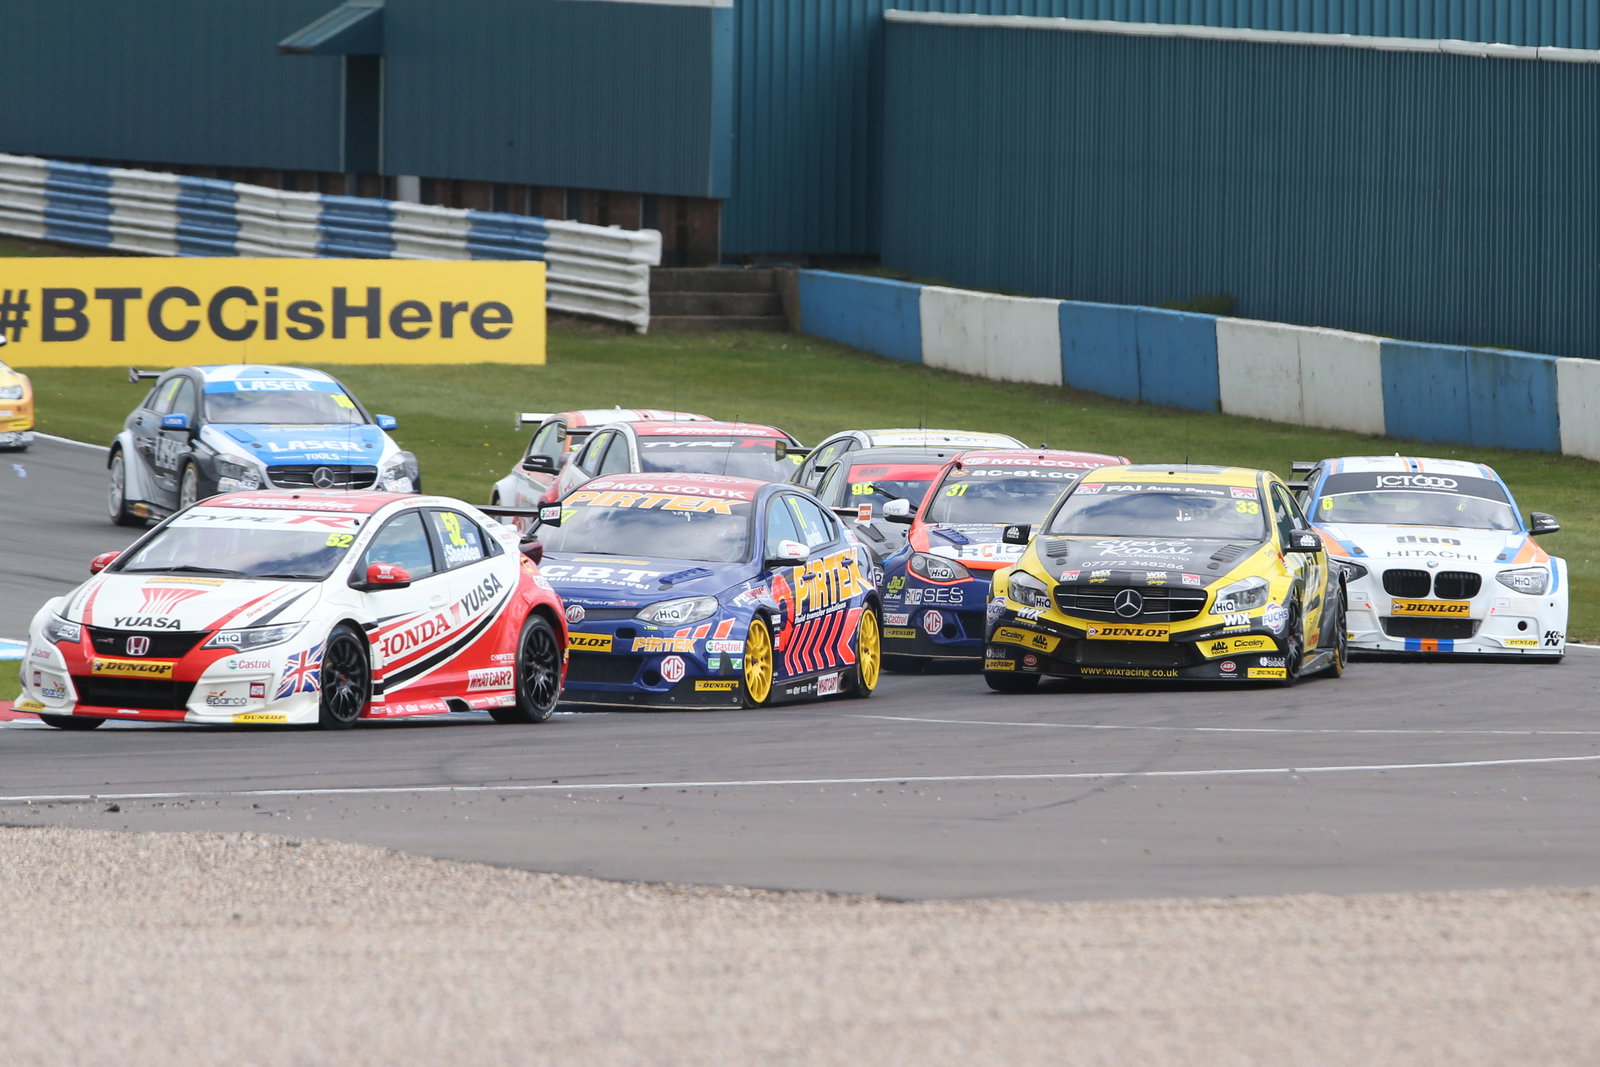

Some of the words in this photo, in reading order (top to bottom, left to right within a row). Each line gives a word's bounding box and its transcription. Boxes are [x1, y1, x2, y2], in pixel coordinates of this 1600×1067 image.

[0, 286, 513, 342] #BTCCisHere
[234, 380, 314, 391] LASER
[267, 440, 367, 453] LASER
[1376, 475, 1458, 489] JCT600
[612, 483, 747, 499] MG.CO.UK
[946, 484, 968, 497] 31
[1106, 485, 1142, 493] FAI
[1185, 487, 1225, 495] Parts
[560, 490, 752, 515] PIRTEK
[1235, 500, 1259, 515] 33
[1322, 497, 1334, 511] 6
[326, 533, 353, 548] 52
[1386, 550, 1478, 561] HITACHI
[1082, 560, 1127, 568] 07772
[540, 565, 663, 583] CBT
[602, 578, 651, 590] Travel
[793, 547, 874, 617] PIRTEK
[461, 573, 503, 617] YUASA
[924, 587, 964, 603] SES
[826, 602, 847, 614] solutions
[1216, 602, 1234, 612] HiQ
[1405, 603, 1470, 614] DUNLOP
[659, 610, 681, 620] HiQ
[1017, 607, 1045, 621] WIX
[1223, 612, 1251, 626] WIX
[1264, 610, 1289, 624] FUCHS
[113, 617, 182, 630] YUASA
[924, 611, 942, 633] MG
[217, 634, 240, 643] HiQ
[1099, 627, 1169, 638] DUNLOP
[567, 637, 612, 647] NLOP
[631, 637, 699, 653] PIRTEK
[714, 640, 742, 652] Castrol
[105, 662, 172, 674] DUNLOP
[238, 660, 272, 669] Castrol
[662, 656, 685, 682] MG
[206, 697, 248, 708] sparco
